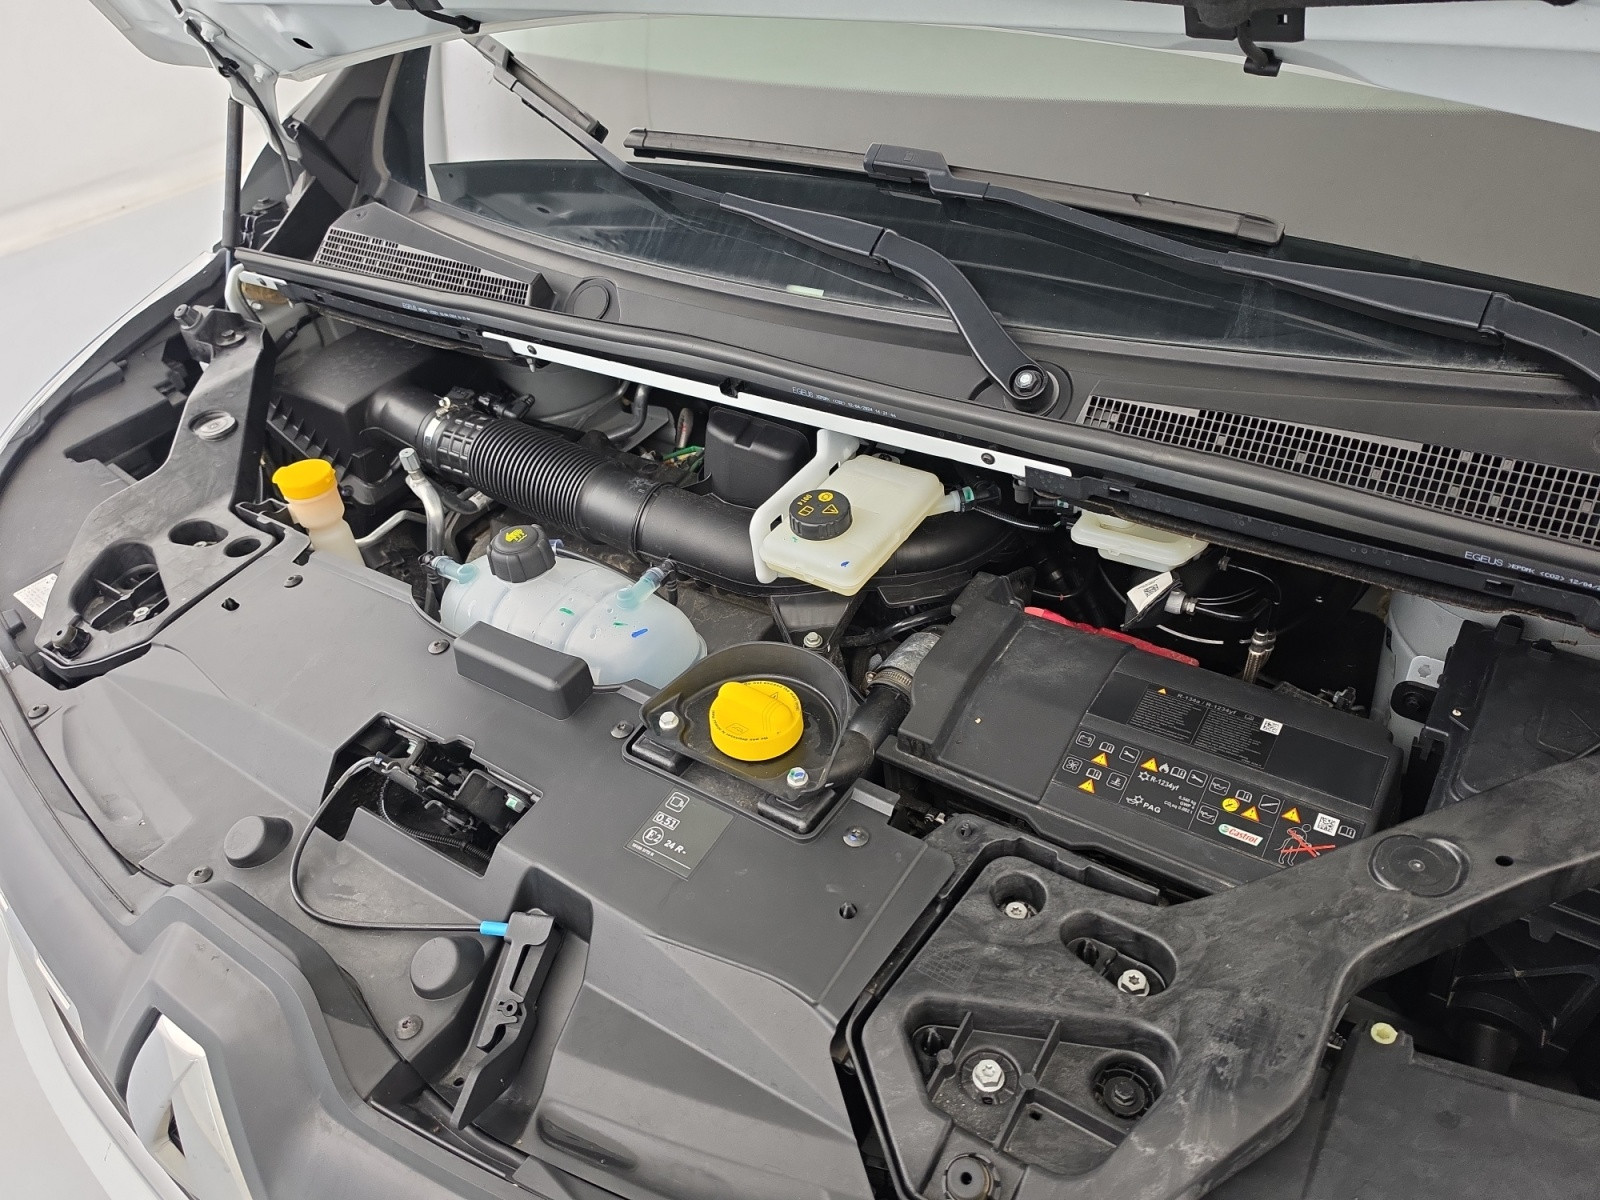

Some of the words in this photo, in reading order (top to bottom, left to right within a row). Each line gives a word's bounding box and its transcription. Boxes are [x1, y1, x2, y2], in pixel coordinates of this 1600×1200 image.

[1464, 550, 1504, 567] EGEUS
[1205, 702, 1237, 715] R-1234yf
[1150, 775, 1180, 791] R-1234yf
[1142, 802, 1161, 813] PAG
[656, 813, 677, 829] 0.51
[645, 829, 662, 842] E2
[1229, 829, 1259, 843] Castrol
